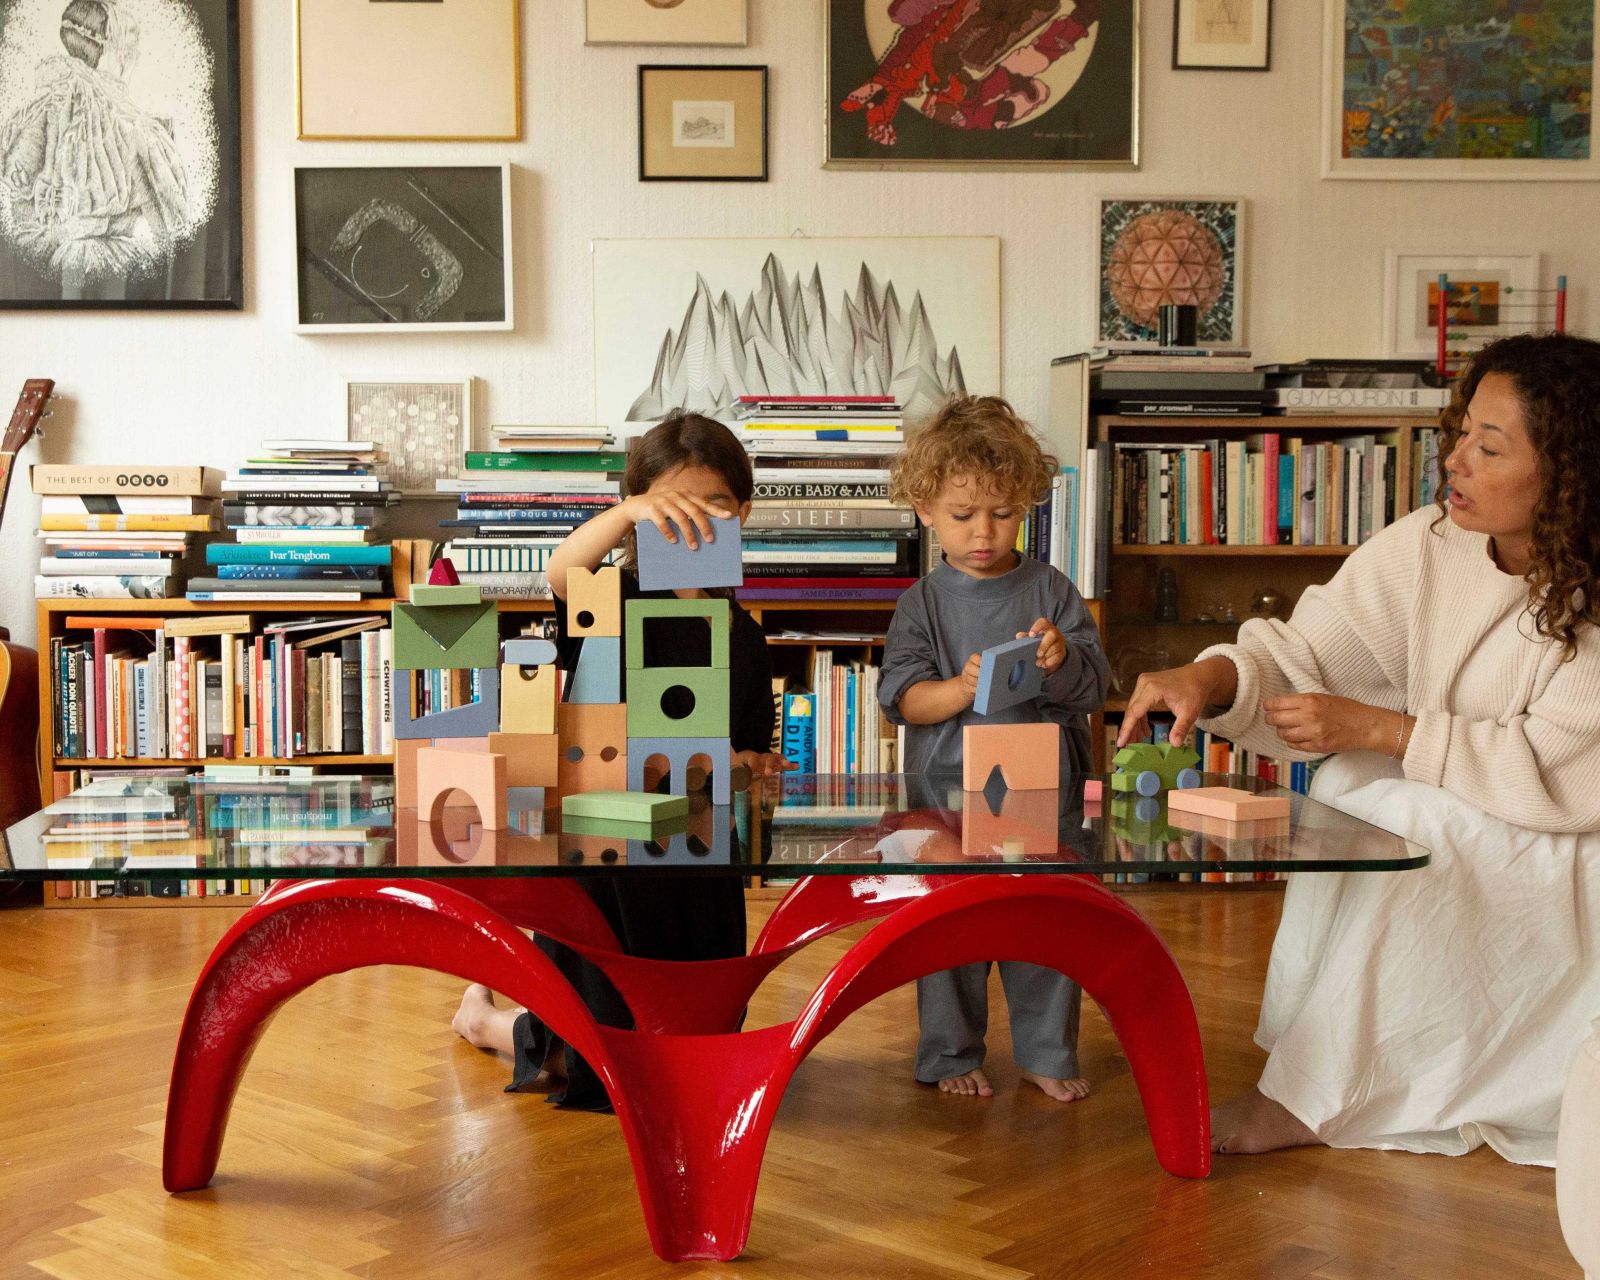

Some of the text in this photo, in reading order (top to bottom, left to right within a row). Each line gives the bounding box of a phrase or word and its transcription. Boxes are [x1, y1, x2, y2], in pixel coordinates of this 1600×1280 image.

[1286, 389, 1324, 406] GUY
[1327, 389, 1404, 406] BOURDIN
[47, 476, 67, 484] THE
[70, 476, 93, 484] BEST
[98, 476, 112, 484] OF
[781, 510, 849, 526] SIEFF
[270, 550, 286, 560] Ivar
[287, 550, 330, 562] Tengbom
[800, 590, 862, 598] JAMES BROWN
[68, 652, 76, 680] ACKER
[383, 660, 391, 723] SCHWITTERS
[803, 725, 813, 754] ANDY
